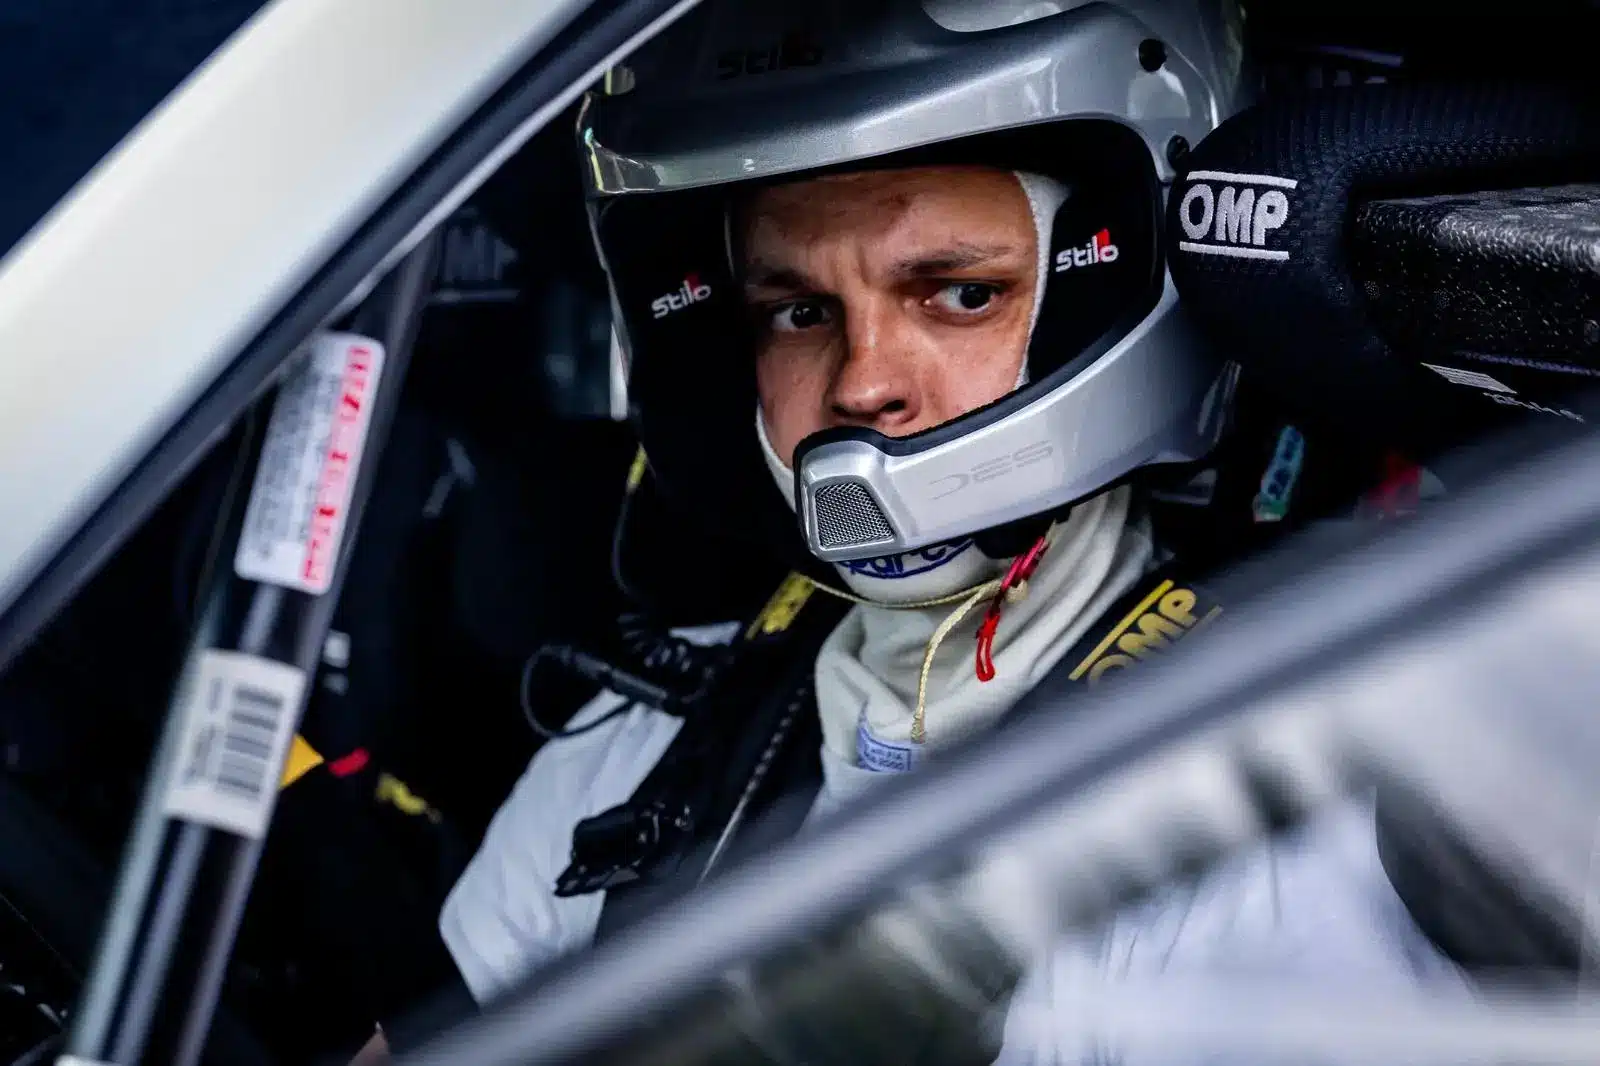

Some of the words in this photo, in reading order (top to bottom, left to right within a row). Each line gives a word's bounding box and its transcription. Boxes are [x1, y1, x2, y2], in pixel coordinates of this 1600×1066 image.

[1179, 183, 1290, 246] OMP
[1055, 232, 1119, 273] stilo
[651, 278, 712, 319] stilo
